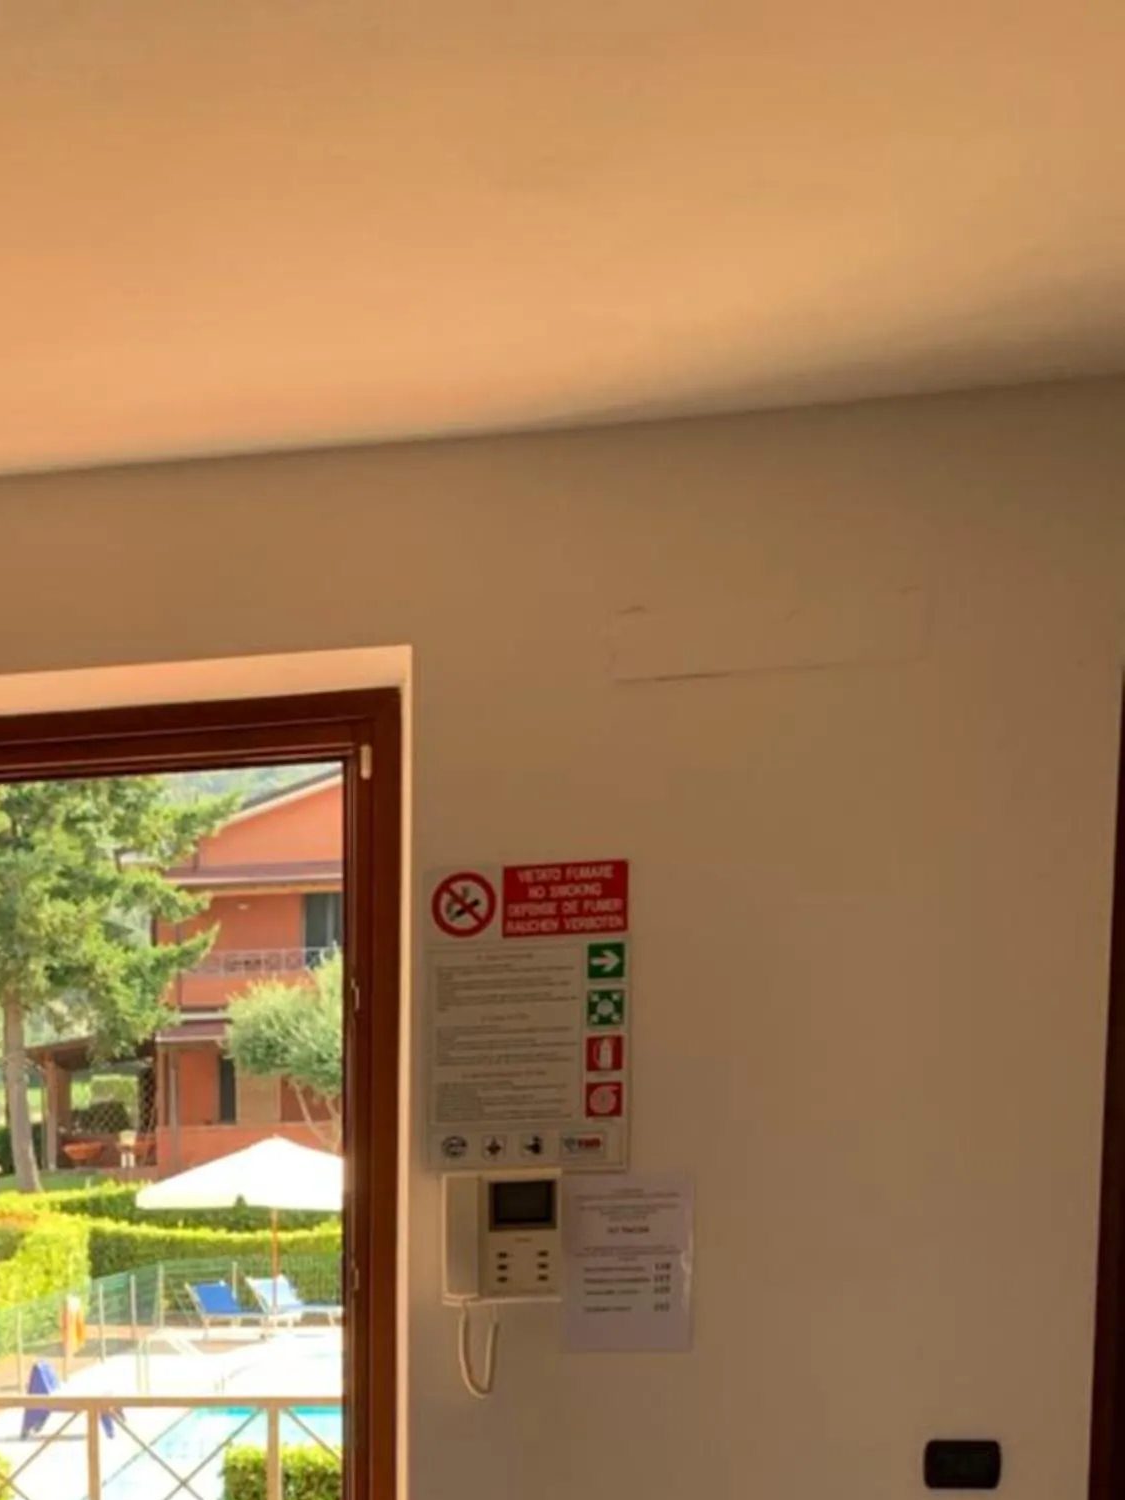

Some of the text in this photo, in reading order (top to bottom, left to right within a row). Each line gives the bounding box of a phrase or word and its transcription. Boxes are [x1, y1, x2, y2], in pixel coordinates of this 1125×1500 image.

[517, 864, 615, 883] VIETATO FUMARE
[527, 882, 603, 899] NO SMOKING
[561, 900, 579, 914] DE
[505, 915, 624, 933] RAUCHEN VERBOTEN
